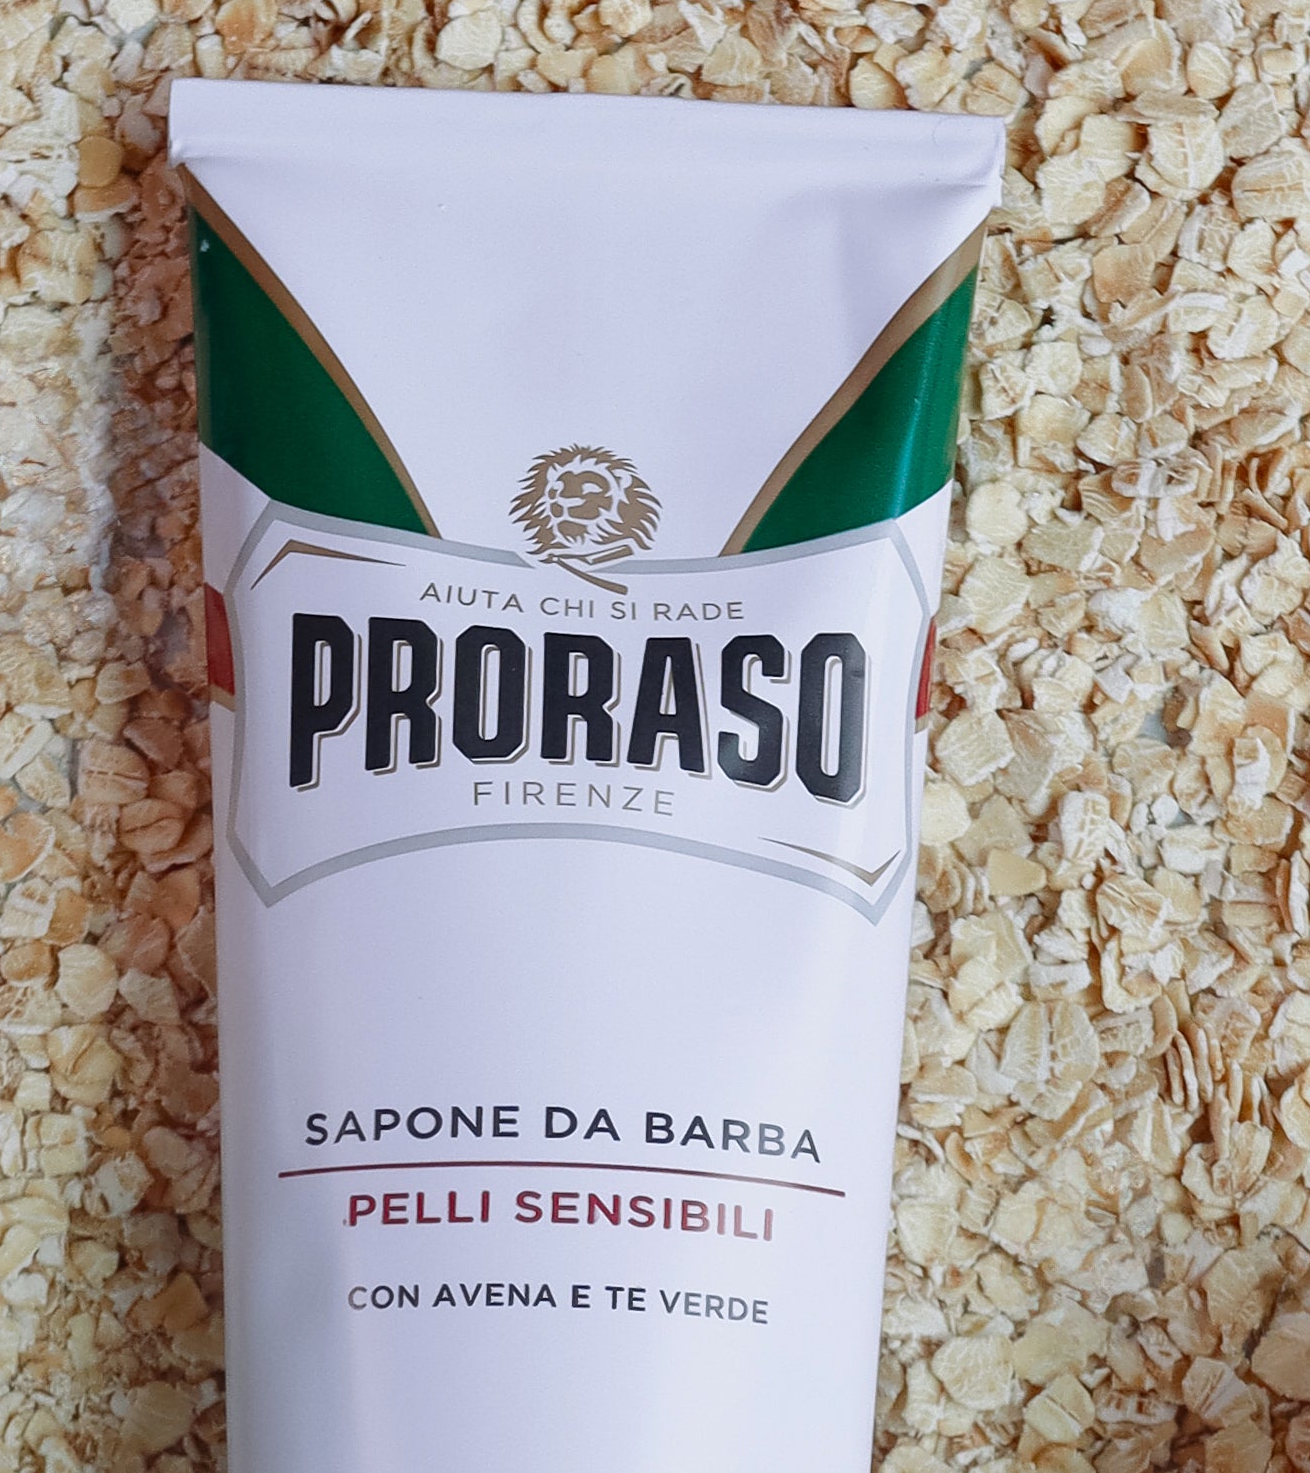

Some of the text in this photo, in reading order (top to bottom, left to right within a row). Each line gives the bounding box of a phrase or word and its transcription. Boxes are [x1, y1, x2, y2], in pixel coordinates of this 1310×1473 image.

[419, 582, 745, 622] AIUTA CHI SI RADE
[290, 611, 874, 805] PRORASO
[472, 780, 674, 816] FIRENZE
[304, 1105, 821, 1164] SAPONE DA BARBA
[348, 1190, 771, 1240] PELLI SENSIBILI
[348, 1282, 769, 1325] CON AVENA E TE VERDE
